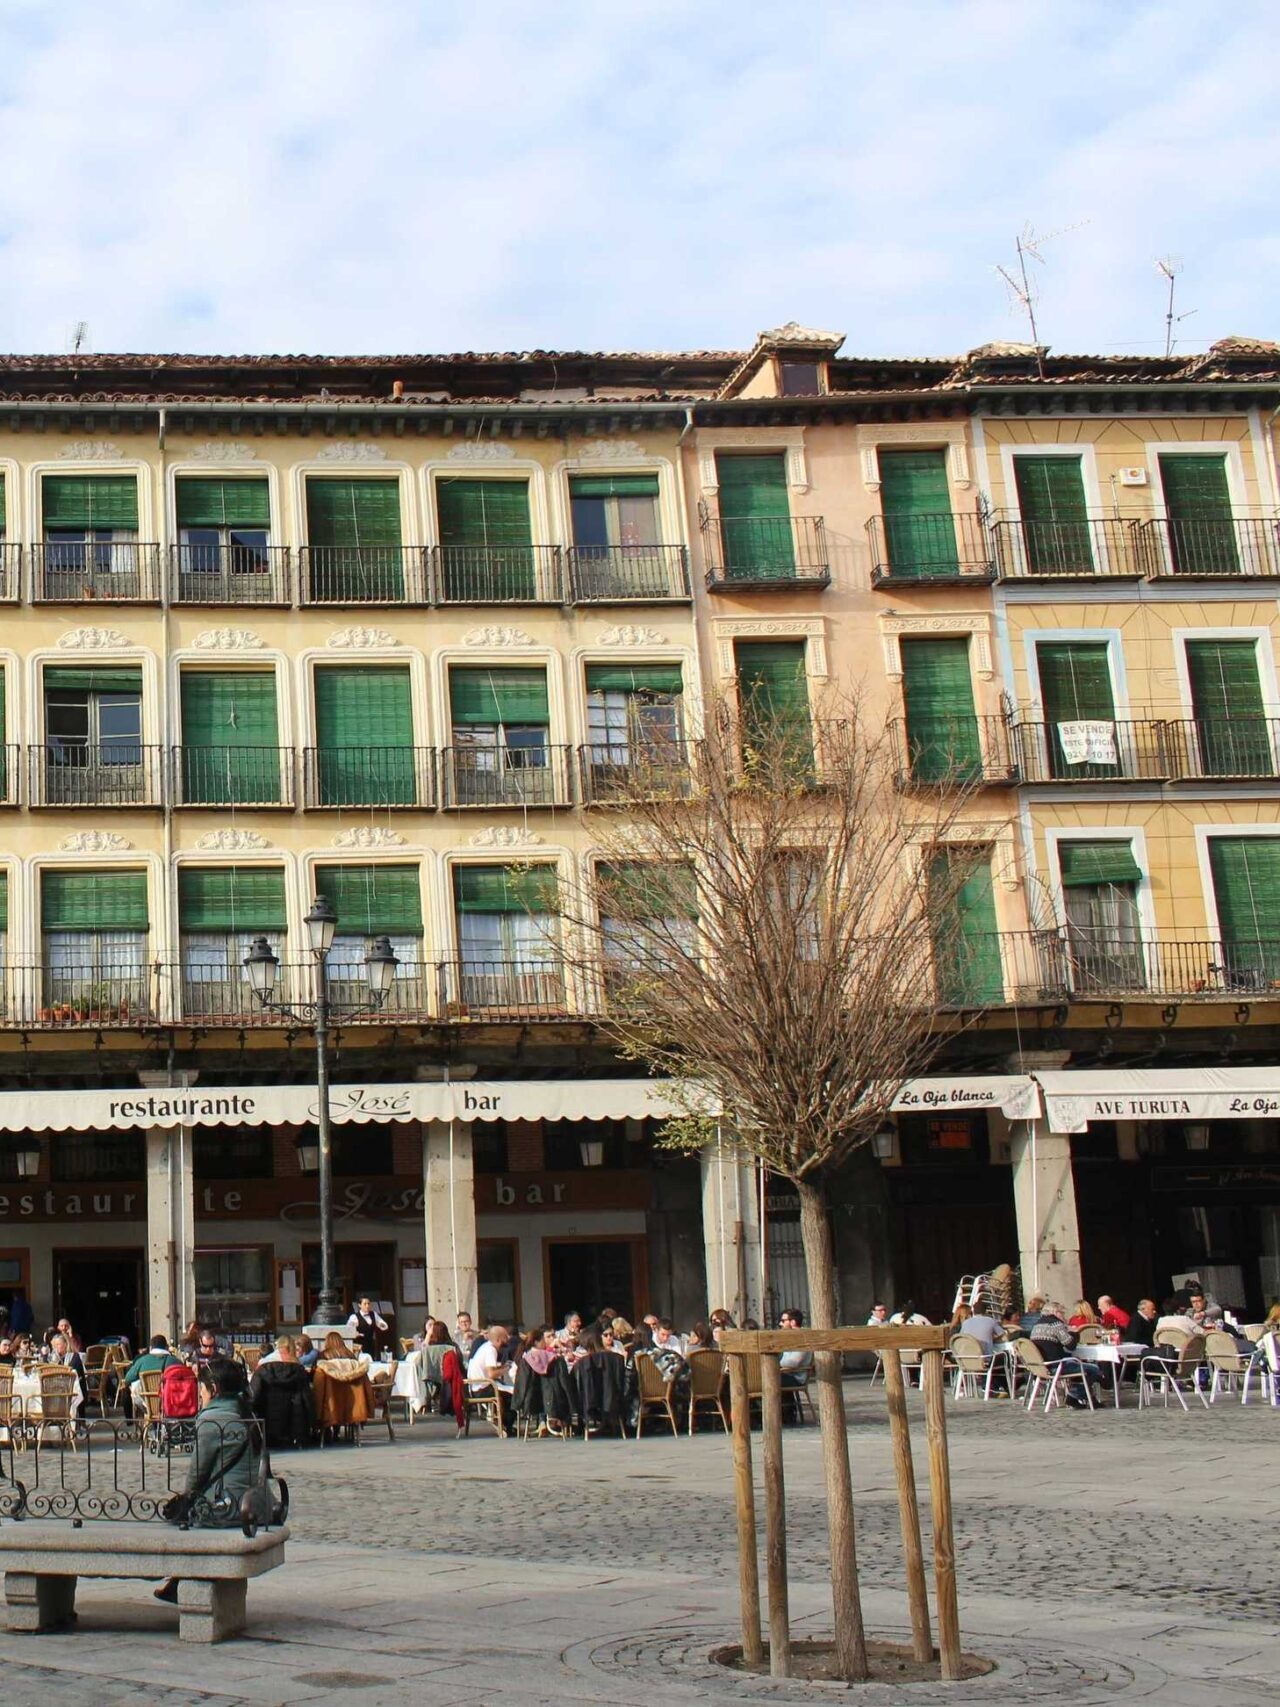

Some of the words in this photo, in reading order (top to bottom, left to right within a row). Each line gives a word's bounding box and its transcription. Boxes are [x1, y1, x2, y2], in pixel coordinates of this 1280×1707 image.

[1063, 726, 1076, 735] SE
[1078, 724, 1112, 734] VENDE
[109, 1094, 256, 1119] restaurante
[309, 1089, 411, 1118] José
[463, 1090, 502, 1111] bar
[899, 1091, 919, 1105] La
[923, 1091, 948, 1106] Oja
[951, 1089, 995, 1102] blanca
[1094, 1101, 1124, 1115] AVE
[1129, 1100, 1191, 1114] TURUTA
[1229, 1098, 1249, 1112] La
[1253, 1098, 1280, 1114] Oja
[496, 1178, 566, 1206] bar
